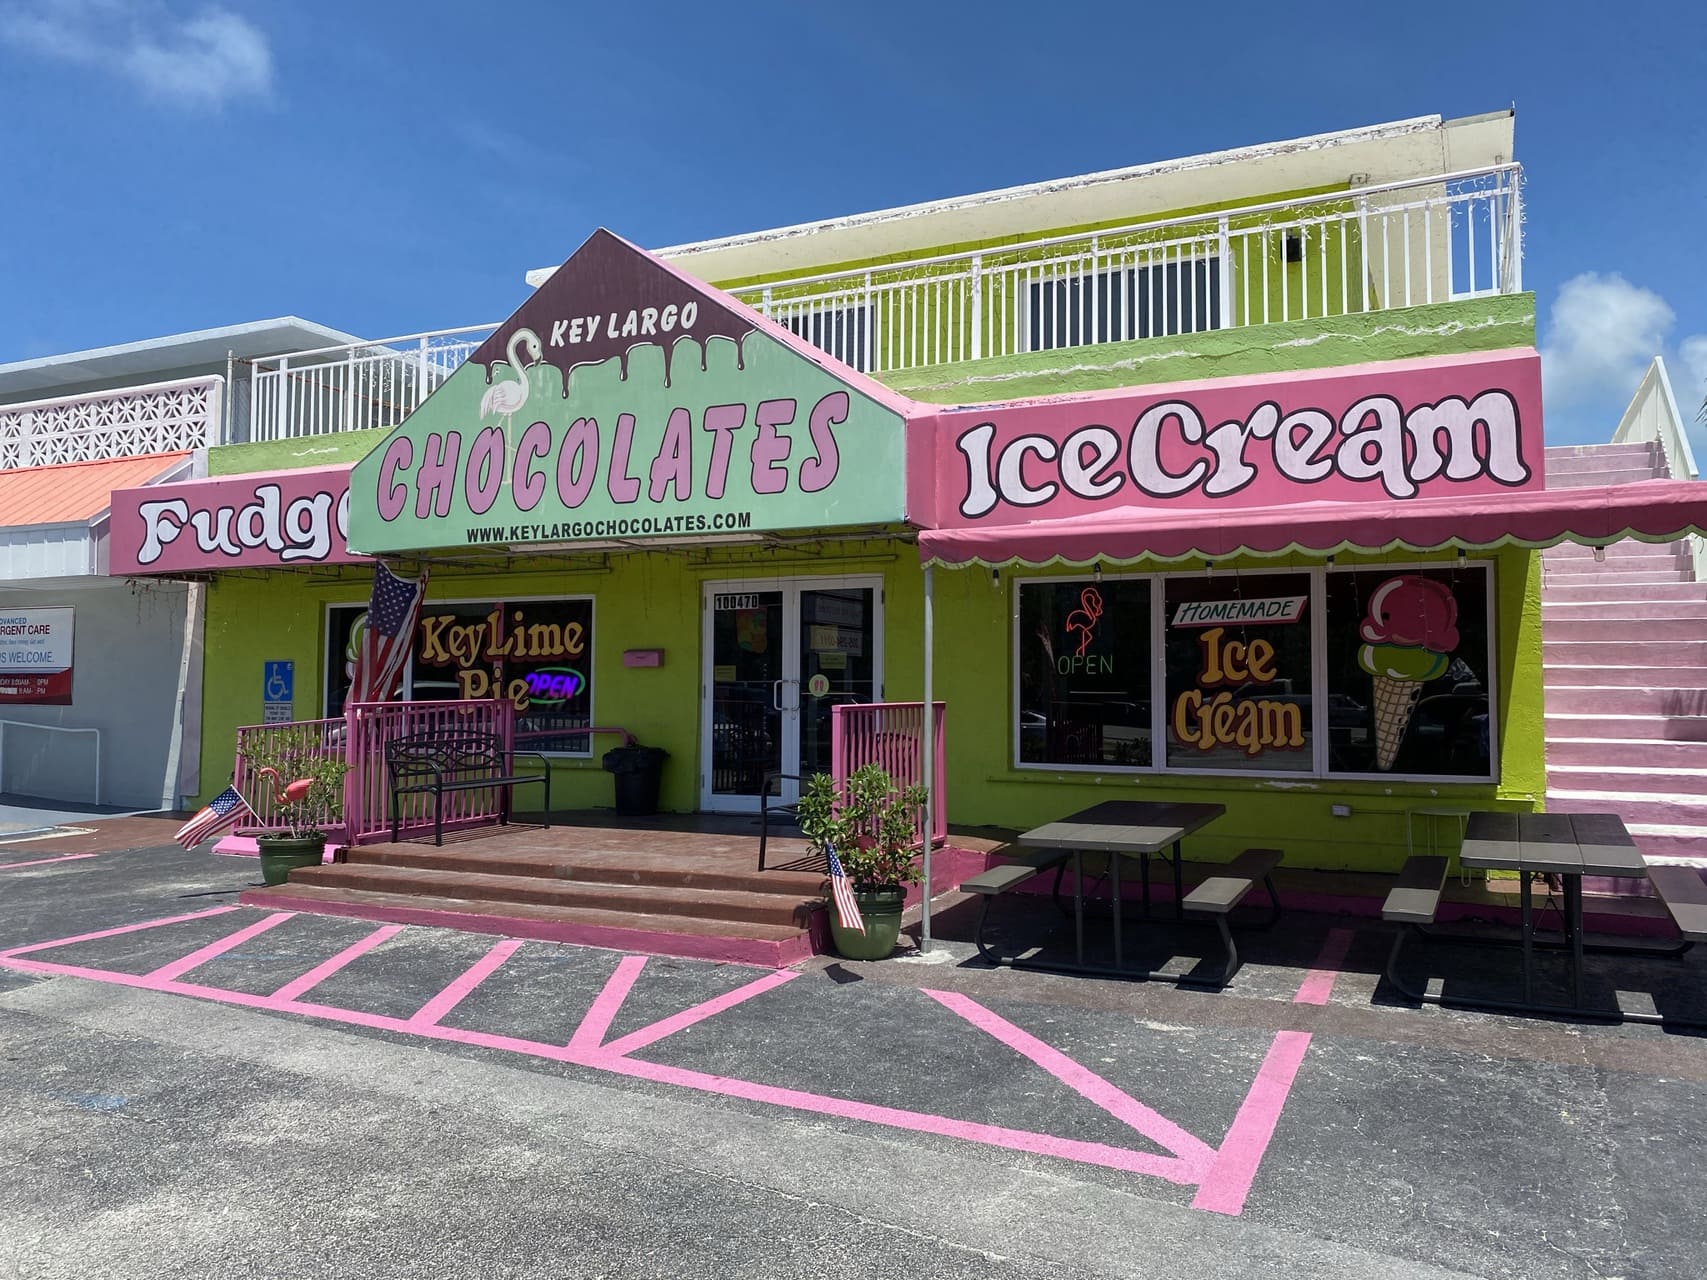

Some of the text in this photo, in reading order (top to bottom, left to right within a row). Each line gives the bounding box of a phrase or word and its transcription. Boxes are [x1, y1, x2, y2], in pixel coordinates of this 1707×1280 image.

[550, 301, 698, 347] KEY LARGO
[377, 391, 850, 521] CHOCOLATES
[466, 511, 751, 543] WWW.KEYLARGOCHOCOLATES.COM
[716, 596, 758, 609] 100470
[1180, 600, 1294, 622] HOMEMADE
[0, 624, 51, 635] RGENT CARE
[1058, 655, 1113, 675] OPEN
[1200, 627, 1277, 683] Ice
[458, 667, 530, 714] Pie
[525, 673, 579, 699] OPEN
[1175, 689, 1306, 754] Cream
